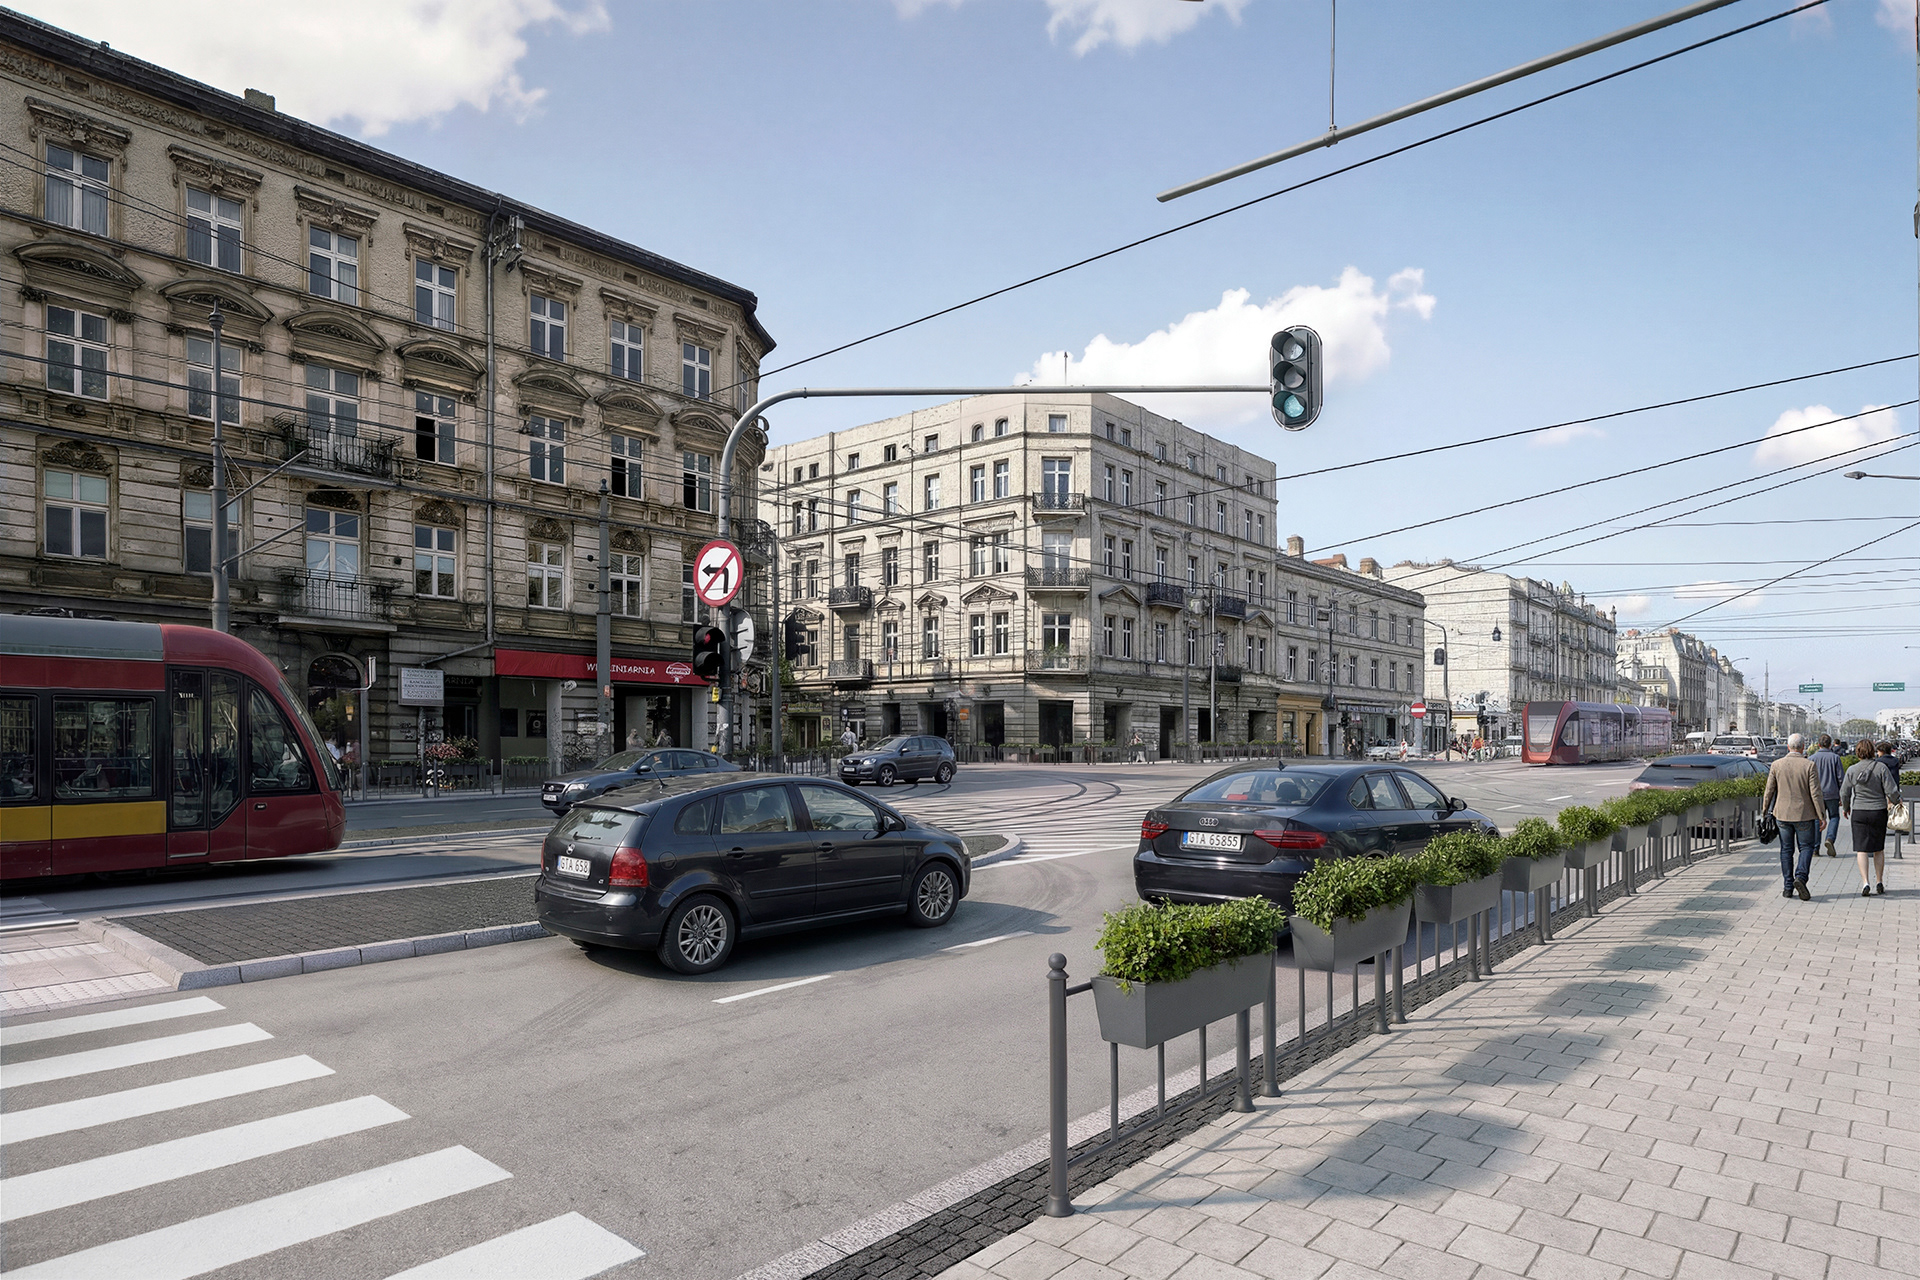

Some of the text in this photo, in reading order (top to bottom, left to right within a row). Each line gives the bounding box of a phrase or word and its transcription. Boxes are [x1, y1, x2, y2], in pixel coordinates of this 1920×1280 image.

[586, 662, 656, 674] WINIARNIA
[1189, 832, 1238, 847] GTA 65855
[575, 859, 588, 873] 658
